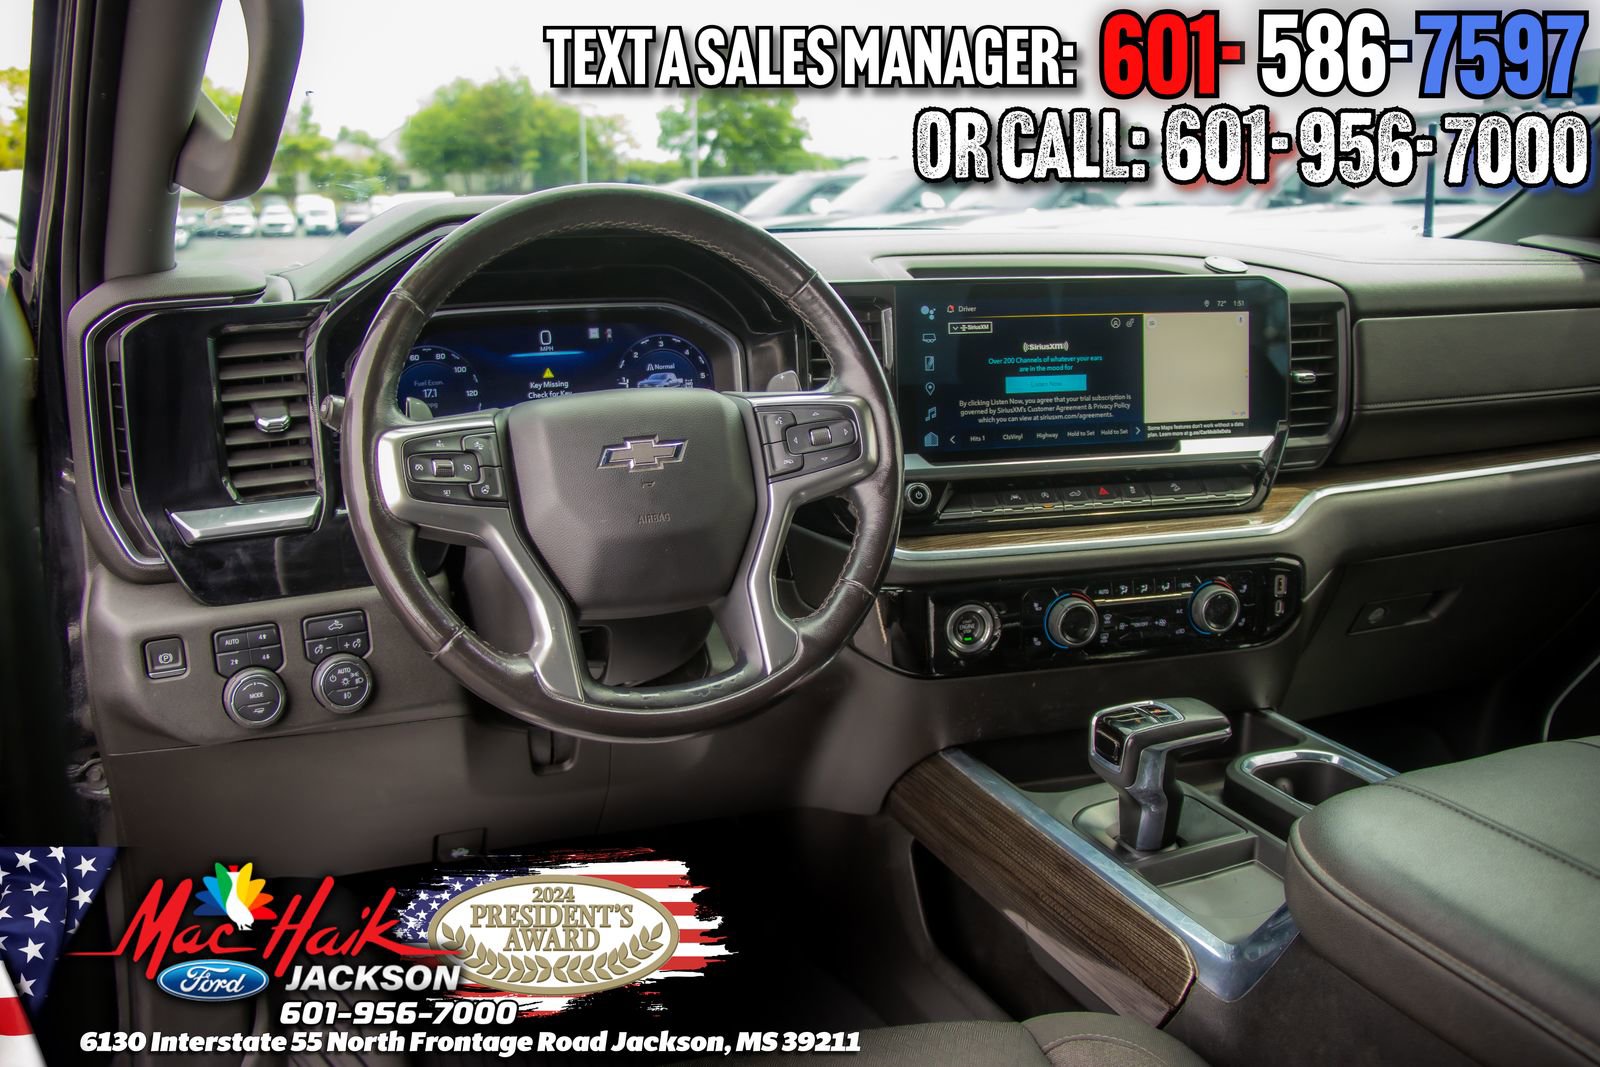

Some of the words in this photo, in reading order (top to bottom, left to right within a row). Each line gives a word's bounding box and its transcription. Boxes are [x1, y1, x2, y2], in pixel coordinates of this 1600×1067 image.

[540, 330, 552, 345] 0
[409, 354, 420, 362] 60
[633, 351, 639, 359] 2
[1016, 356, 1042, 364] Channels
[529, 382, 542, 390] Key
[543, 381, 569, 389] Missing
[423, 388, 438, 398] 17.1
[959, 400, 967, 408] By
[960, 409, 989, 417] governed
[989, 408, 997, 416] by
[1056, 404, 1087, 412] Agreement
[1093, 403, 1113, 411] Privacy
[1114, 402, 1131, 410] Policy
[1036, 432, 1059, 440] Highway
[638, 512, 671, 525] AIRBAG
[225, 638, 239, 646] AUTO
